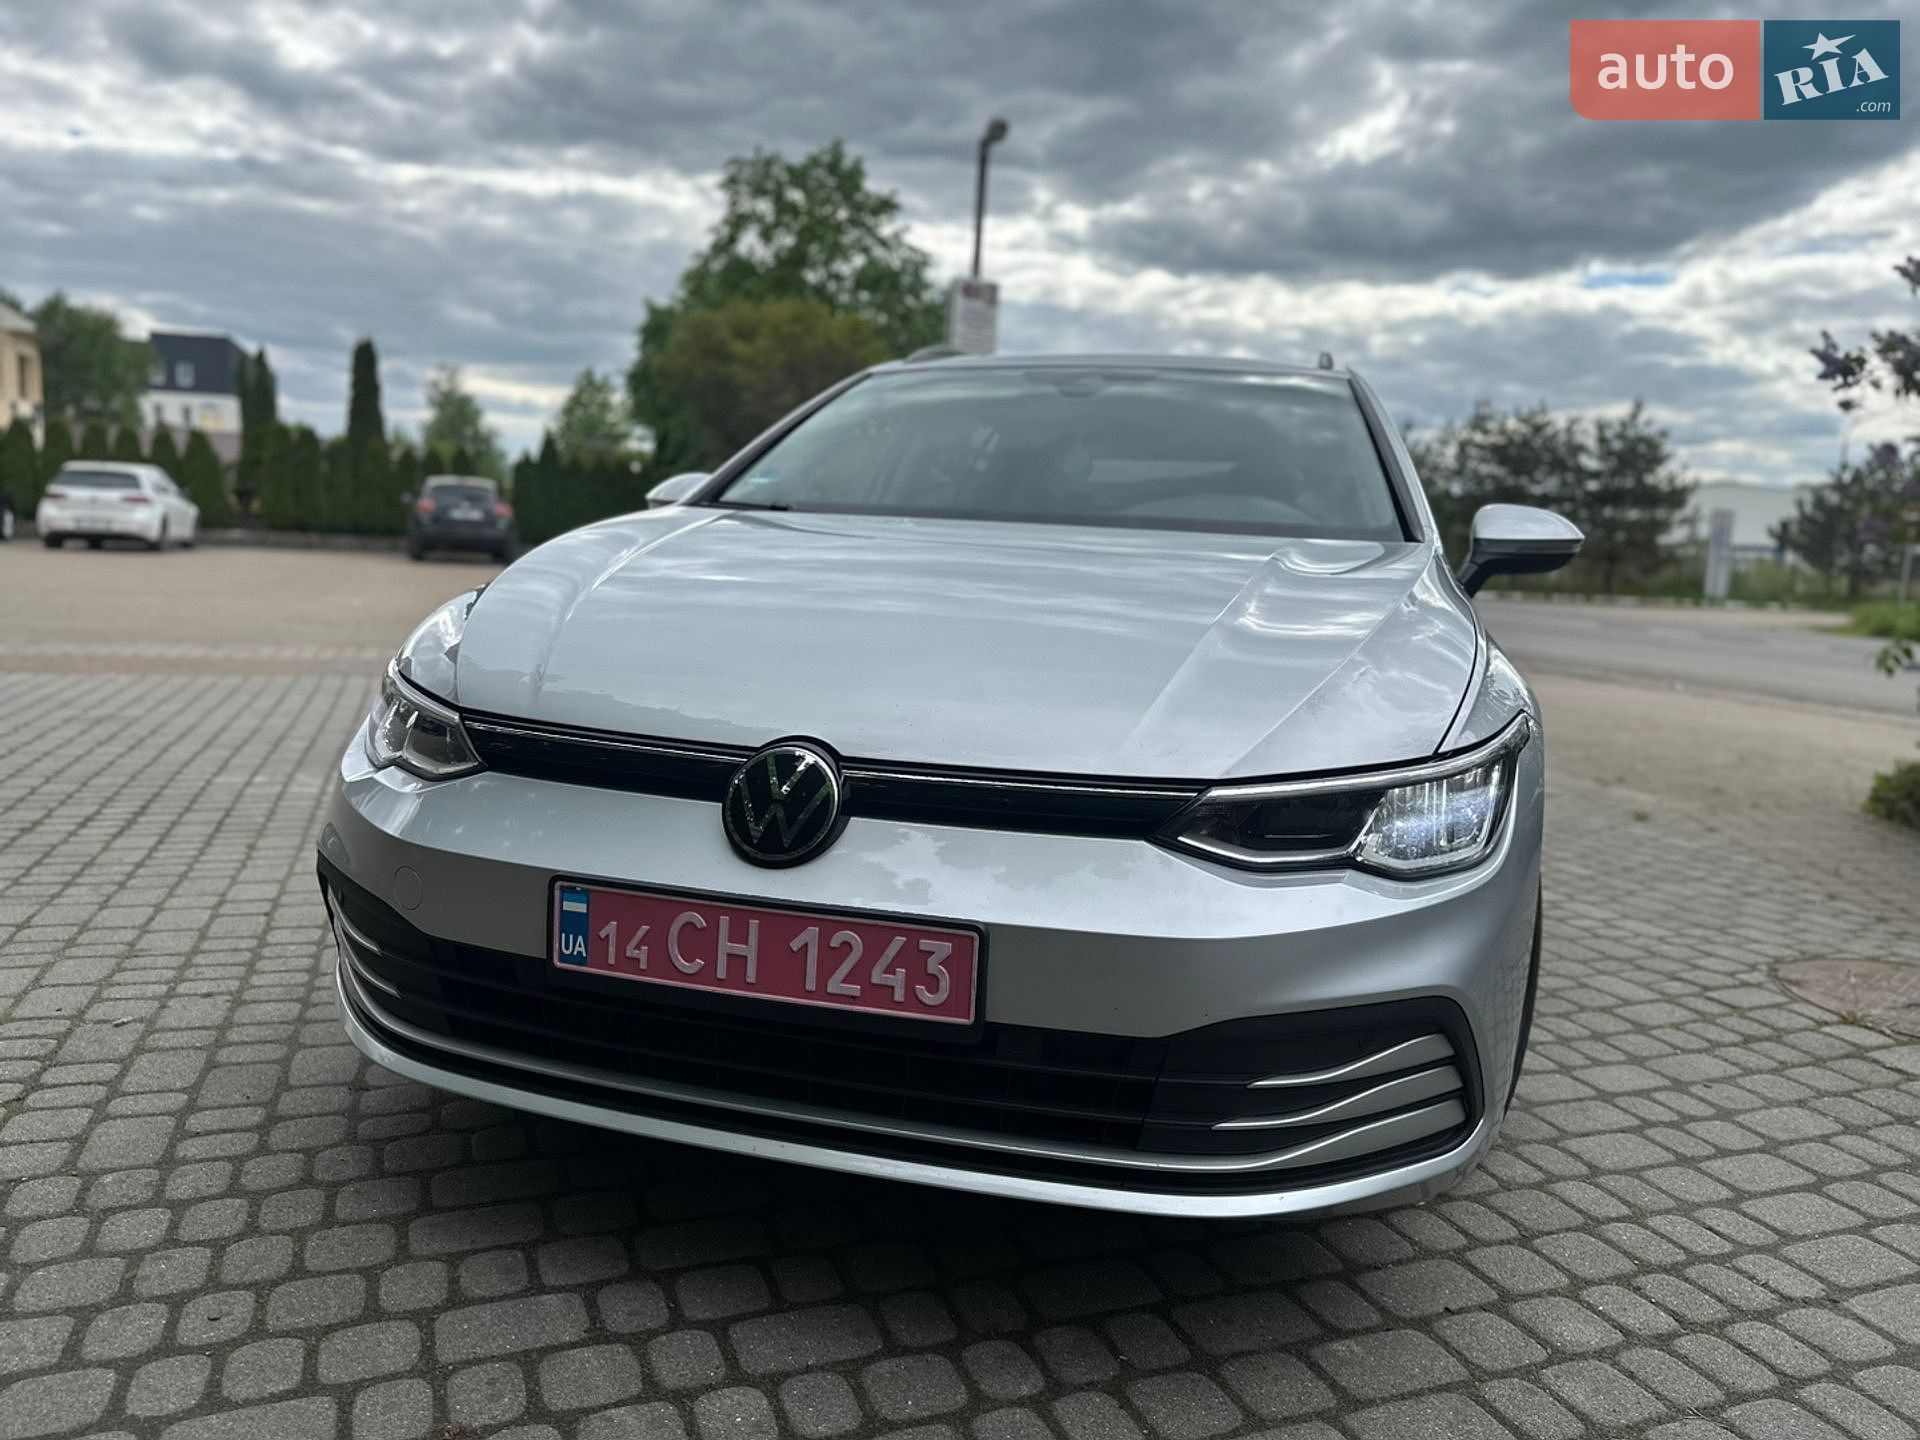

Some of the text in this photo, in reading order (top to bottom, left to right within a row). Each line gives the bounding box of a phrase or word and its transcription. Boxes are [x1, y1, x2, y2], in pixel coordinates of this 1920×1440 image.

[561, 933, 587, 958] UA
[599, 911, 953, 1006] 14 CH 1243
